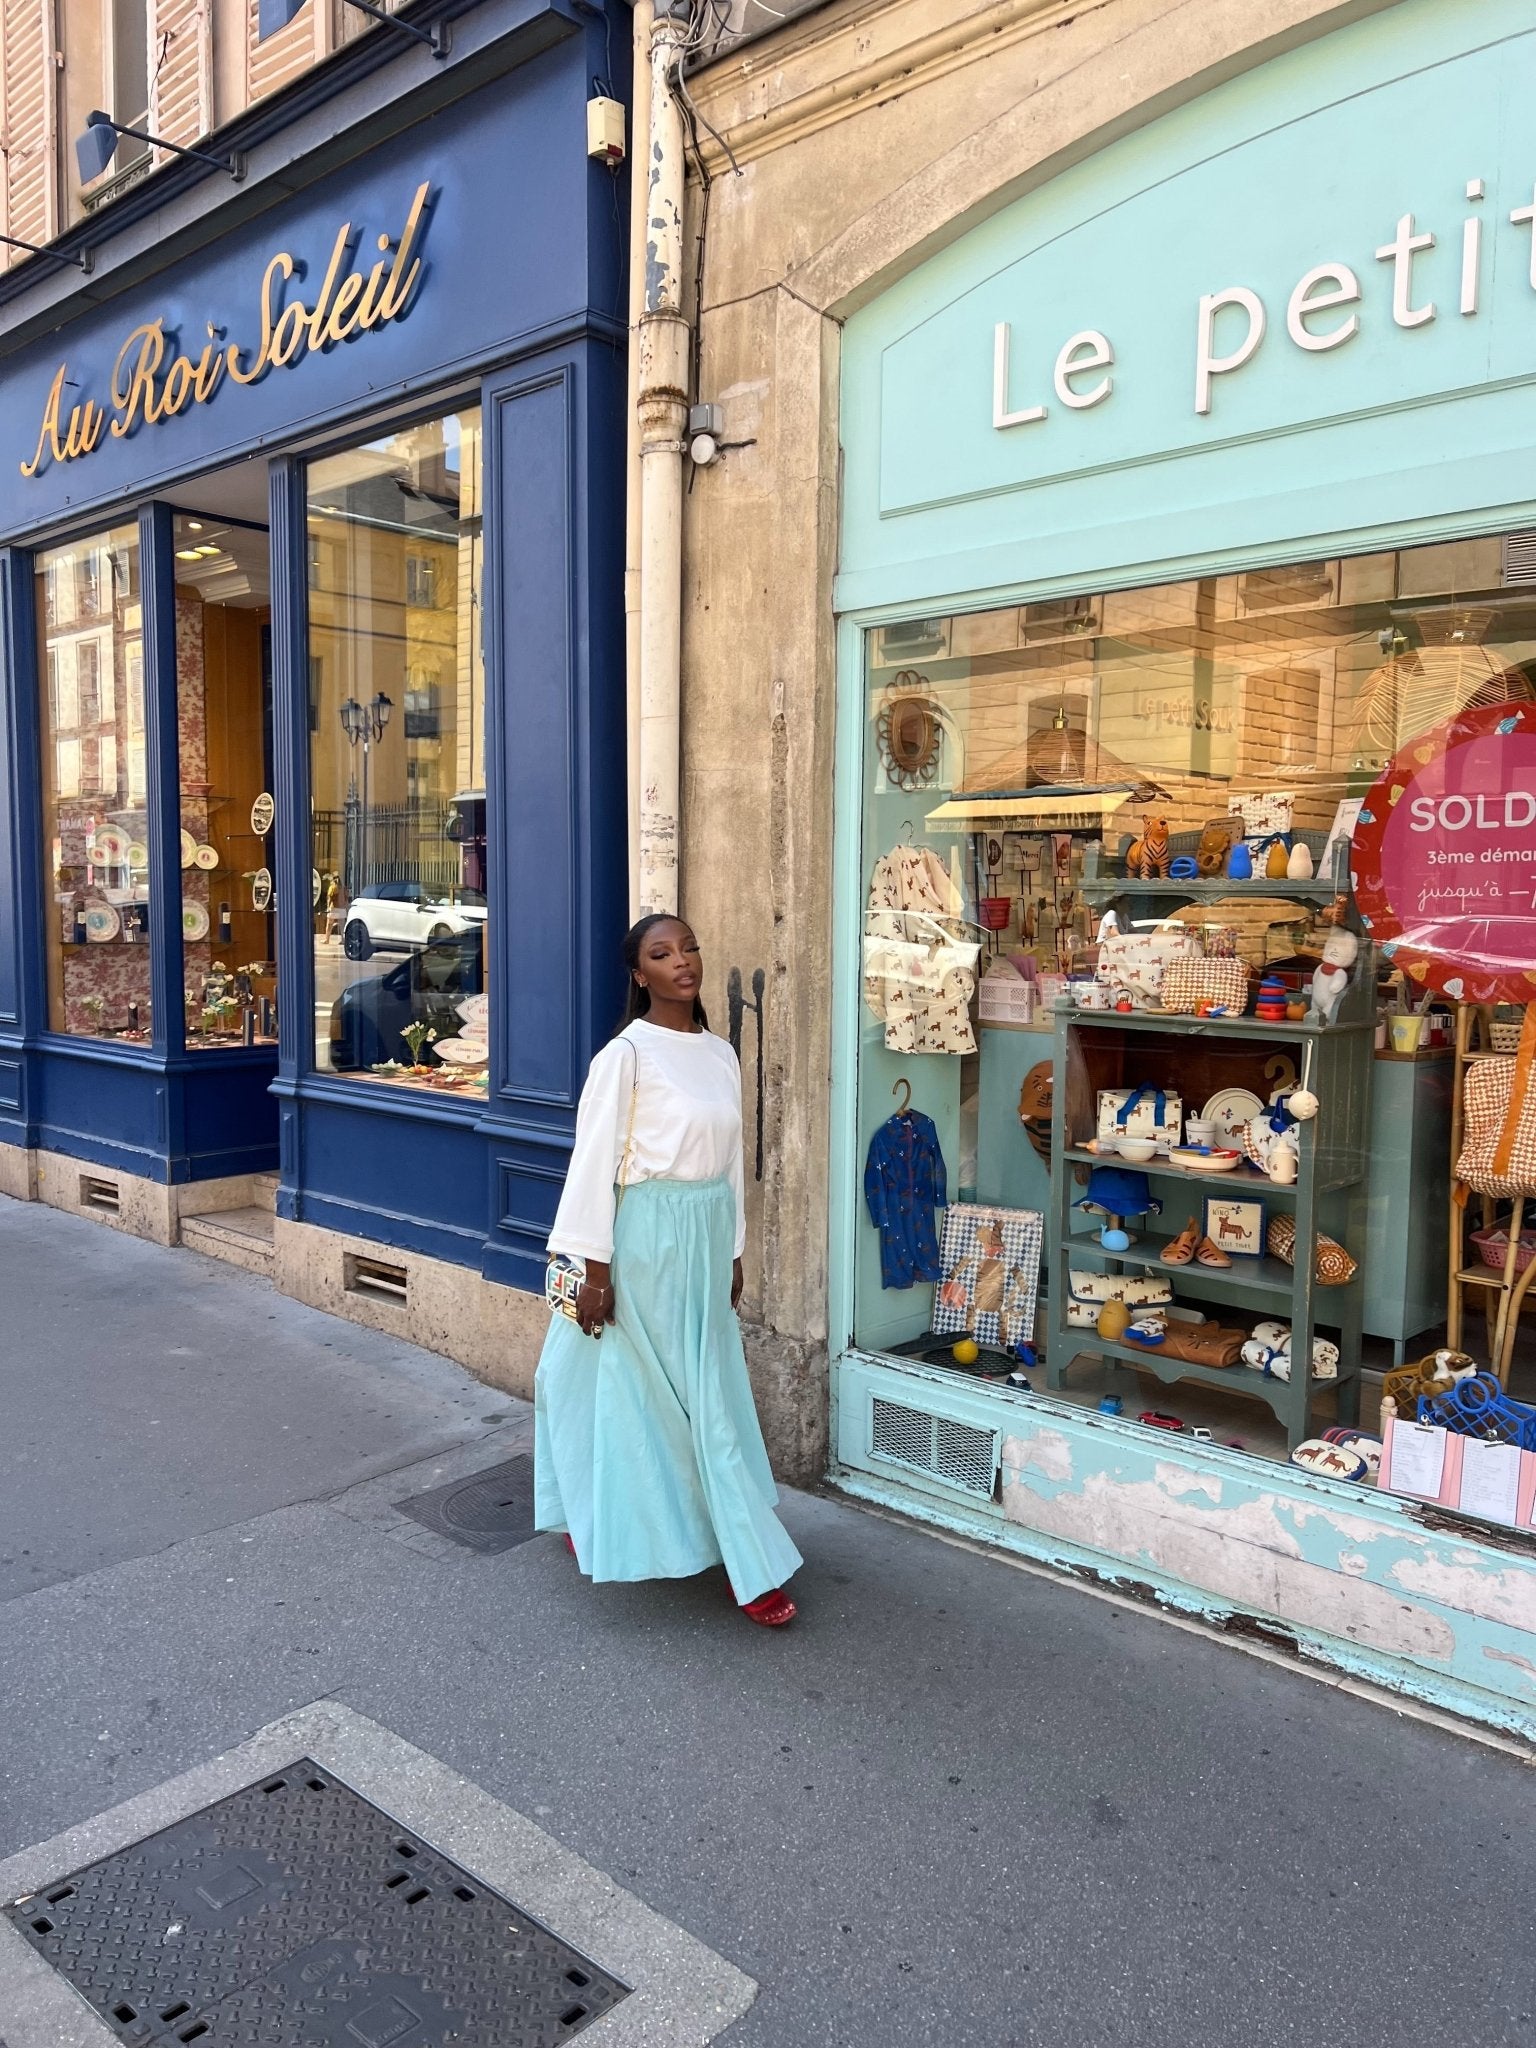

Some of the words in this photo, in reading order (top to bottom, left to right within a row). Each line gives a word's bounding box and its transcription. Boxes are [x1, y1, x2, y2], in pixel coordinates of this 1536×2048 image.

[20, 363, 103, 477] Au
[111, 317, 223, 438] Roi
[226, 180, 430, 384] Soleil
[993, 322, 1115, 430] Le
[1410, 791, 1536, 832] SOLD
[1427, 850, 1475, 865] 3ème
[1480, 847, 1536, 863] déma
[1417, 880, 1503, 911] jusqu'à
